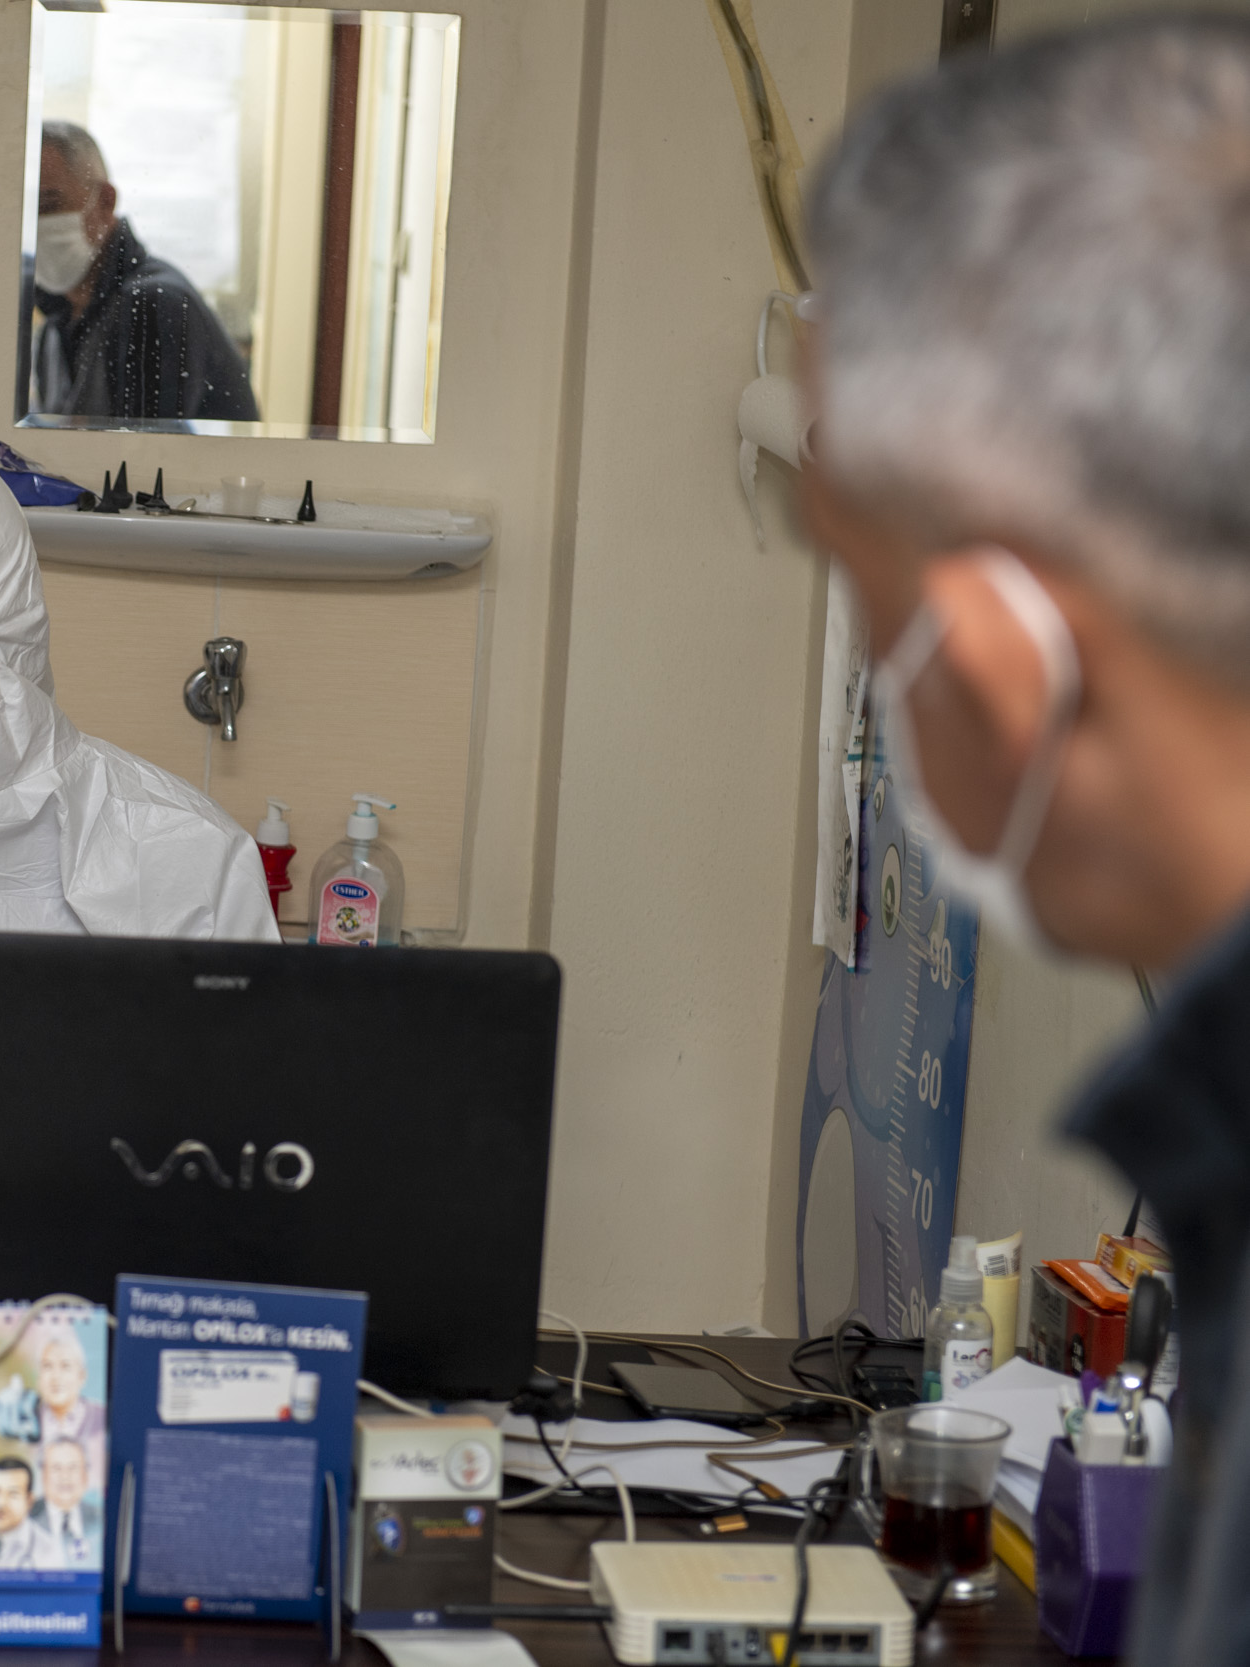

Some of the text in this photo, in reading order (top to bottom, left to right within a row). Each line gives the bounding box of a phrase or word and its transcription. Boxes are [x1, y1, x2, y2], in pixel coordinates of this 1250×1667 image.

[929, 931, 952, 991] 90
[917, 1049, 943, 1110] 80
[110, 1137, 315, 1193] VAIO
[911, 1167, 933, 1231] 70
